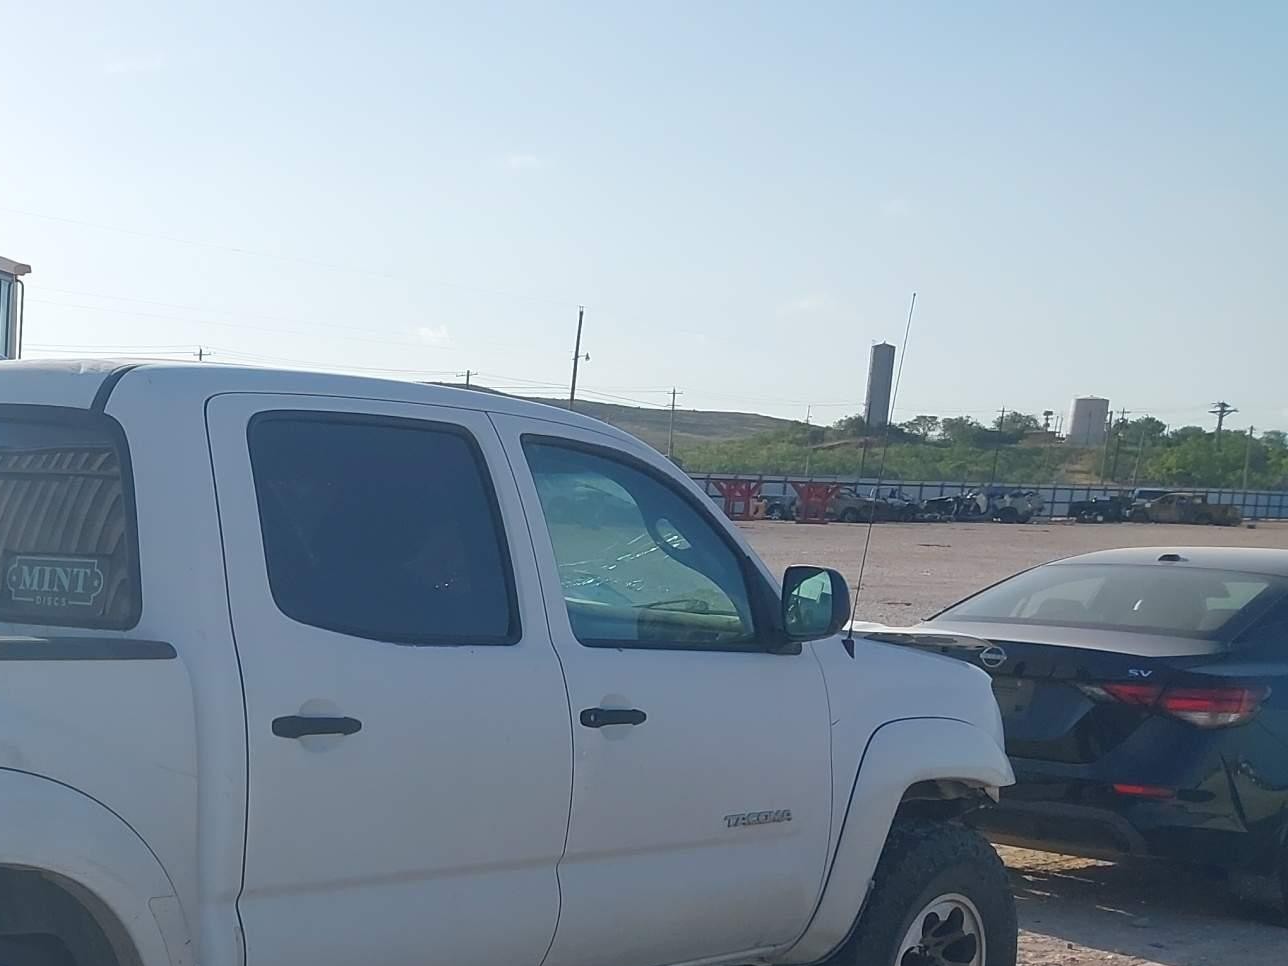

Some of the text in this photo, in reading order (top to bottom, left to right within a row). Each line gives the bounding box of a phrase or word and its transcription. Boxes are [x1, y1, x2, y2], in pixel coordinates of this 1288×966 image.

[18, 564, 91, 594] MINT
[35, 595, 66, 606] DISCS
[1128, 669, 1152, 677] SV
[723, 808, 793, 828] TACOMA
